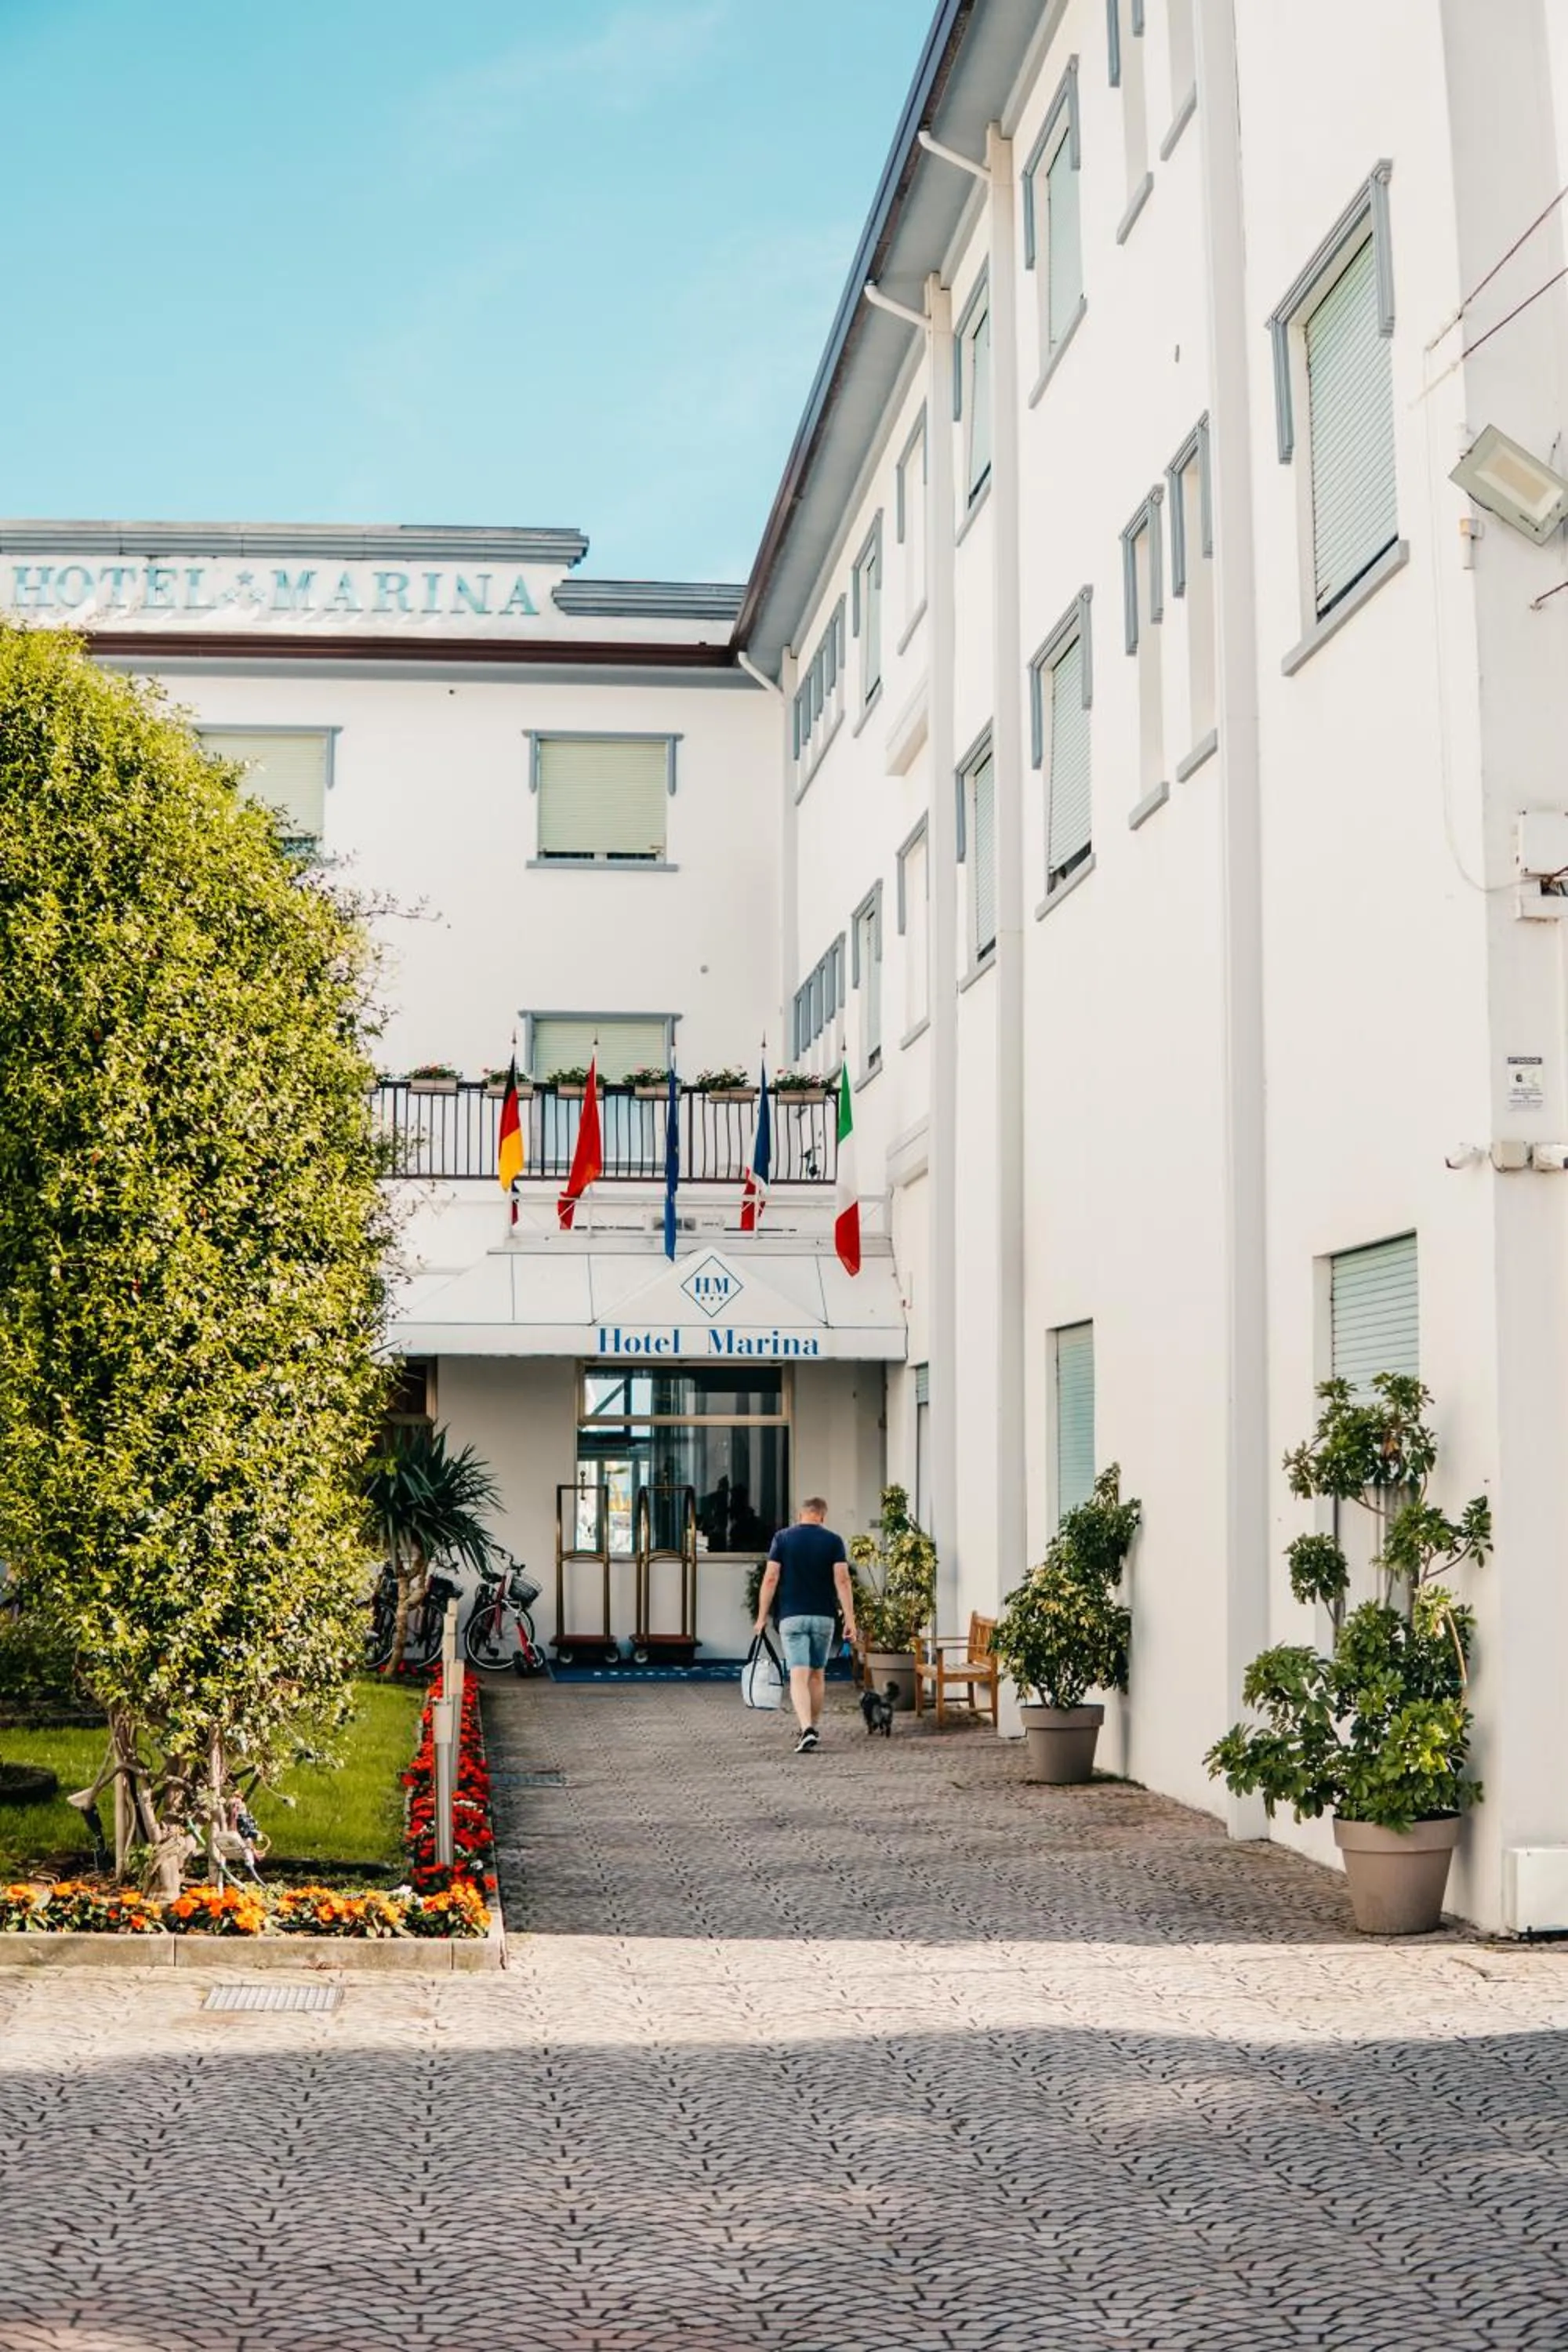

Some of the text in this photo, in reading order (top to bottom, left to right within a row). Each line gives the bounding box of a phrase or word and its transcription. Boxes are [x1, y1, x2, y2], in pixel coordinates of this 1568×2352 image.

[11, 565, 540, 615] HOTEL MARINA
[695, 1277, 729, 1294] HM
[599, 1328, 819, 1356] Hotel Marina
